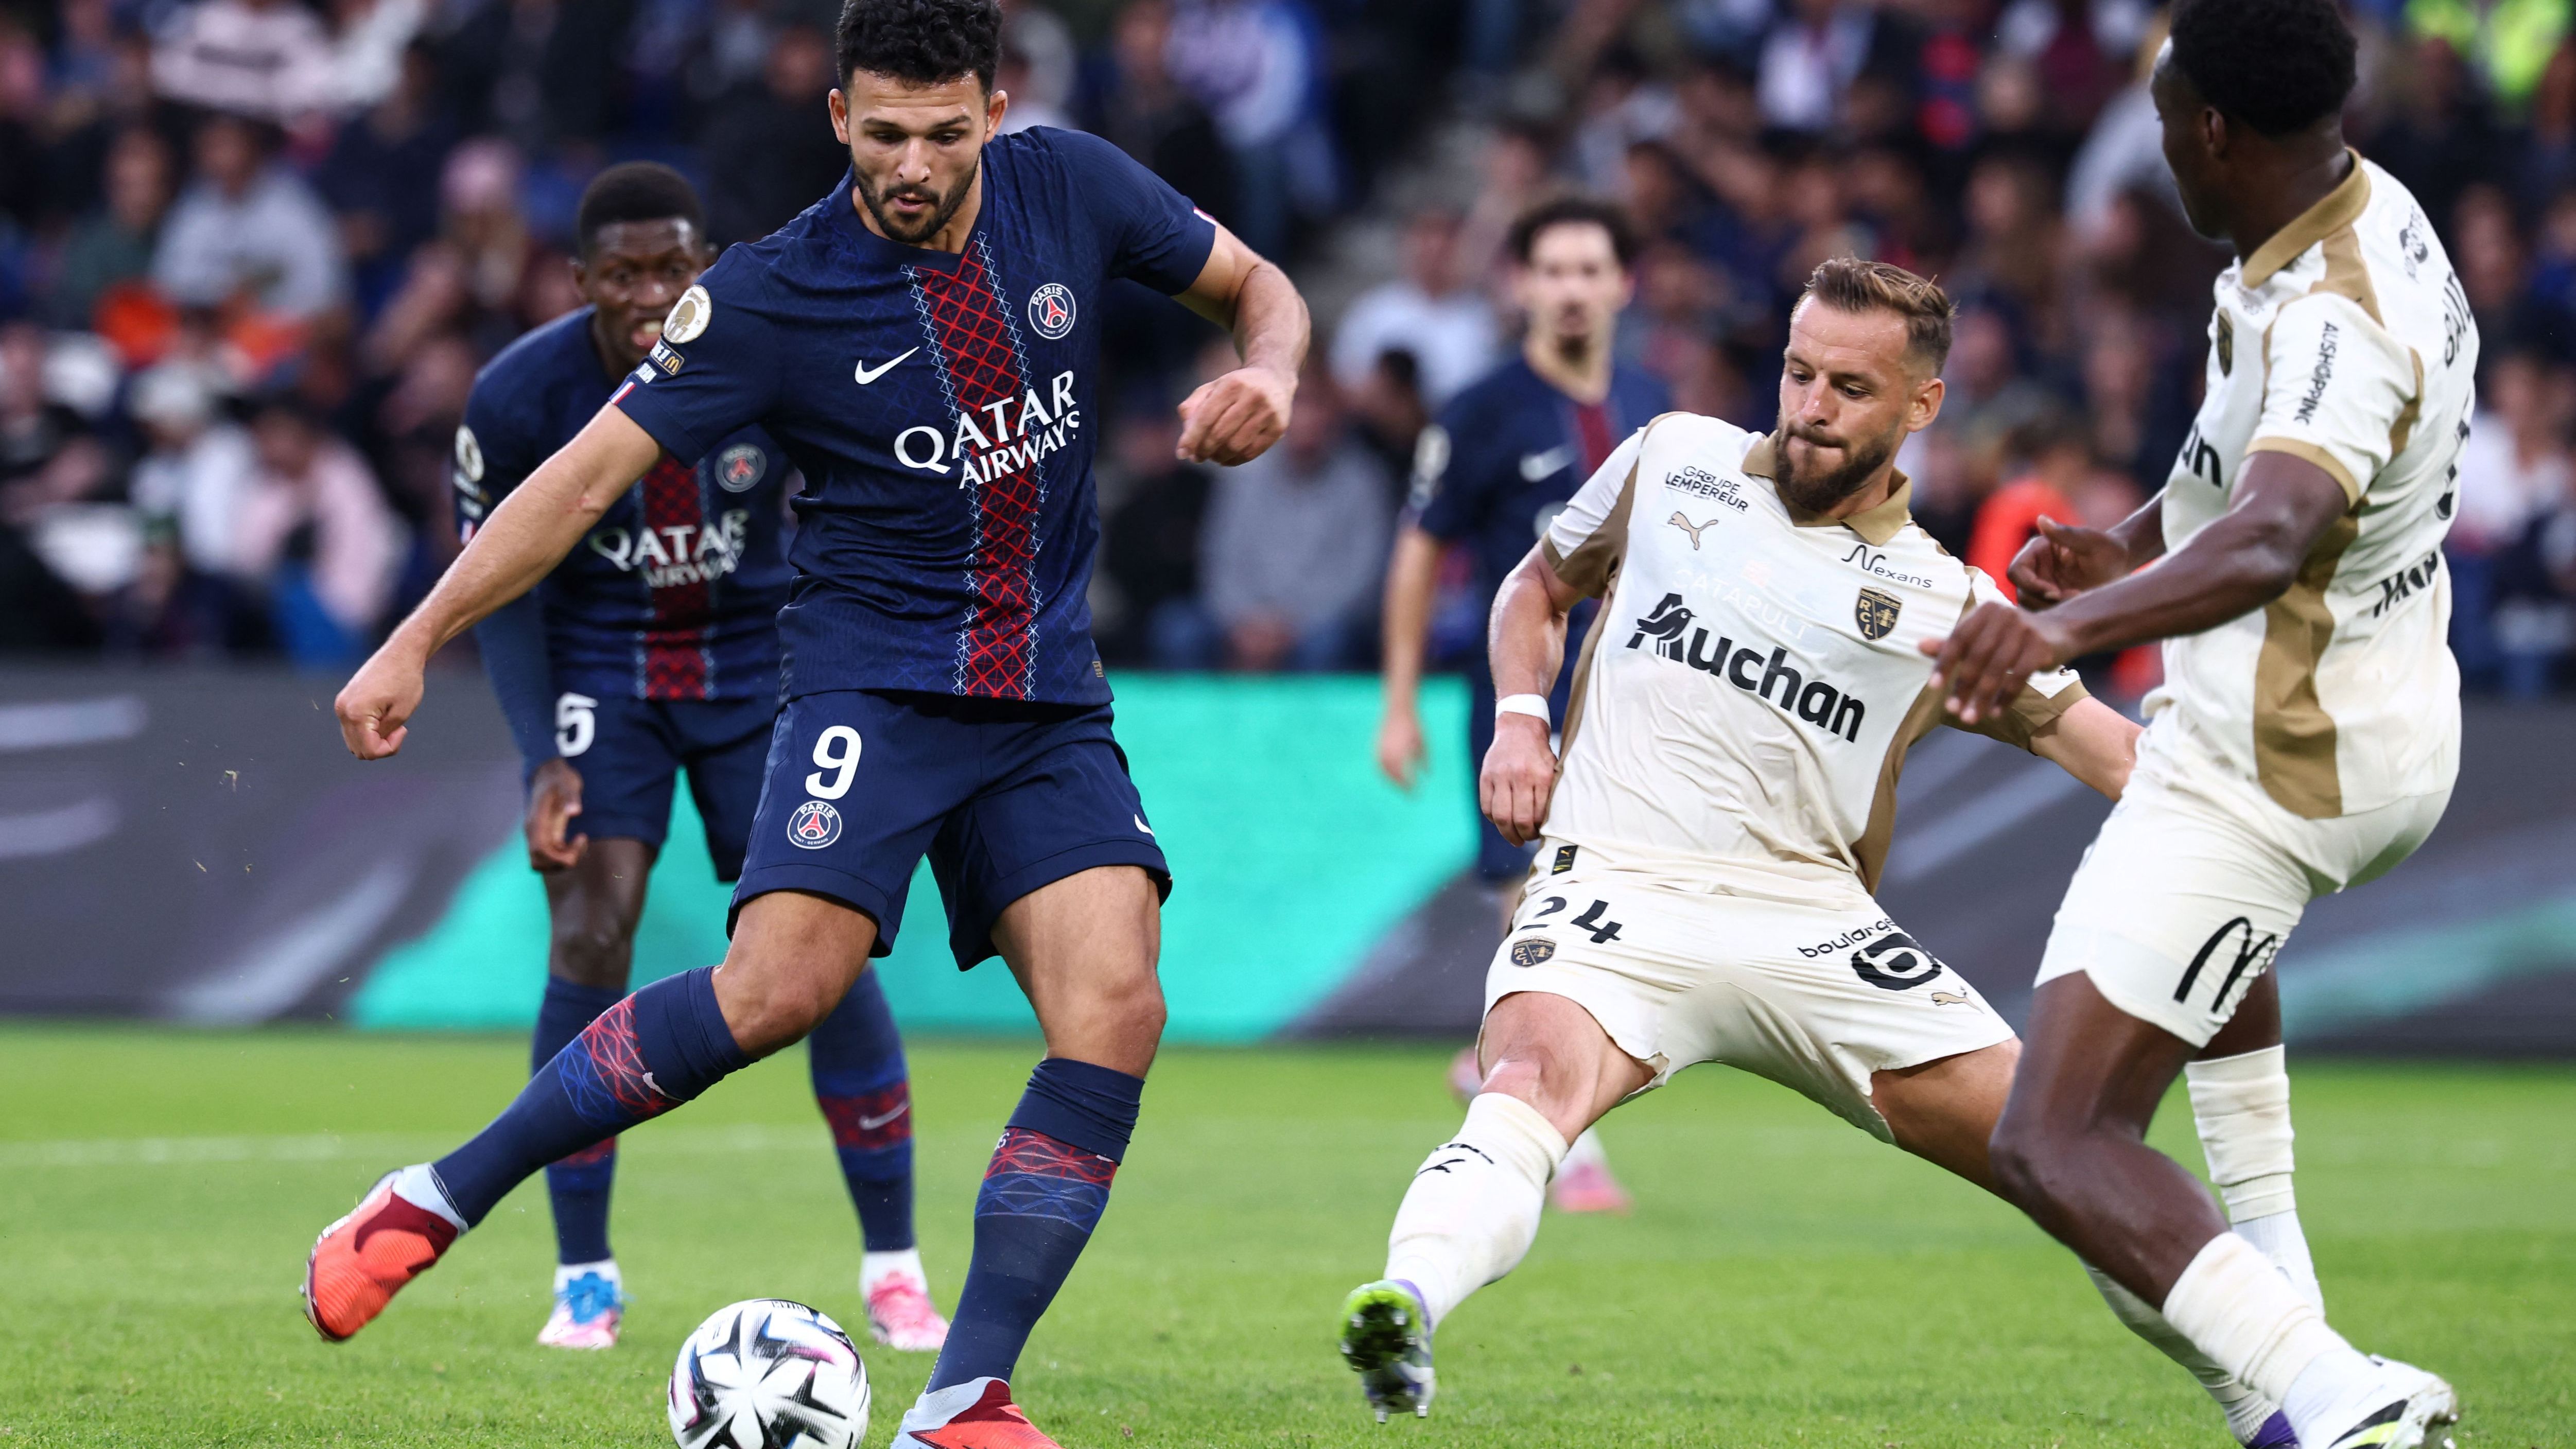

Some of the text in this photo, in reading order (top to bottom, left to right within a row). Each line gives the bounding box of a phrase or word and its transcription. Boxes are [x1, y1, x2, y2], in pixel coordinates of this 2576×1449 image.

[1032, 286, 1064, 306] PARIS
[894, 370, 1077, 475] QATAR
[1665, 472, 1749, 512] LEMPEREUR
[1683, 465, 1741, 495] GROUPE
[588, 509, 751, 572] QATAR
[1840, 544, 1934, 588] Nexans
[1626, 592, 1866, 744] Auchan
[554, 691, 599, 758] 5
[805, 725, 862, 800] 9
[799, 803, 836, 819] PARIS
[1517, 896, 1623, 945] 24
